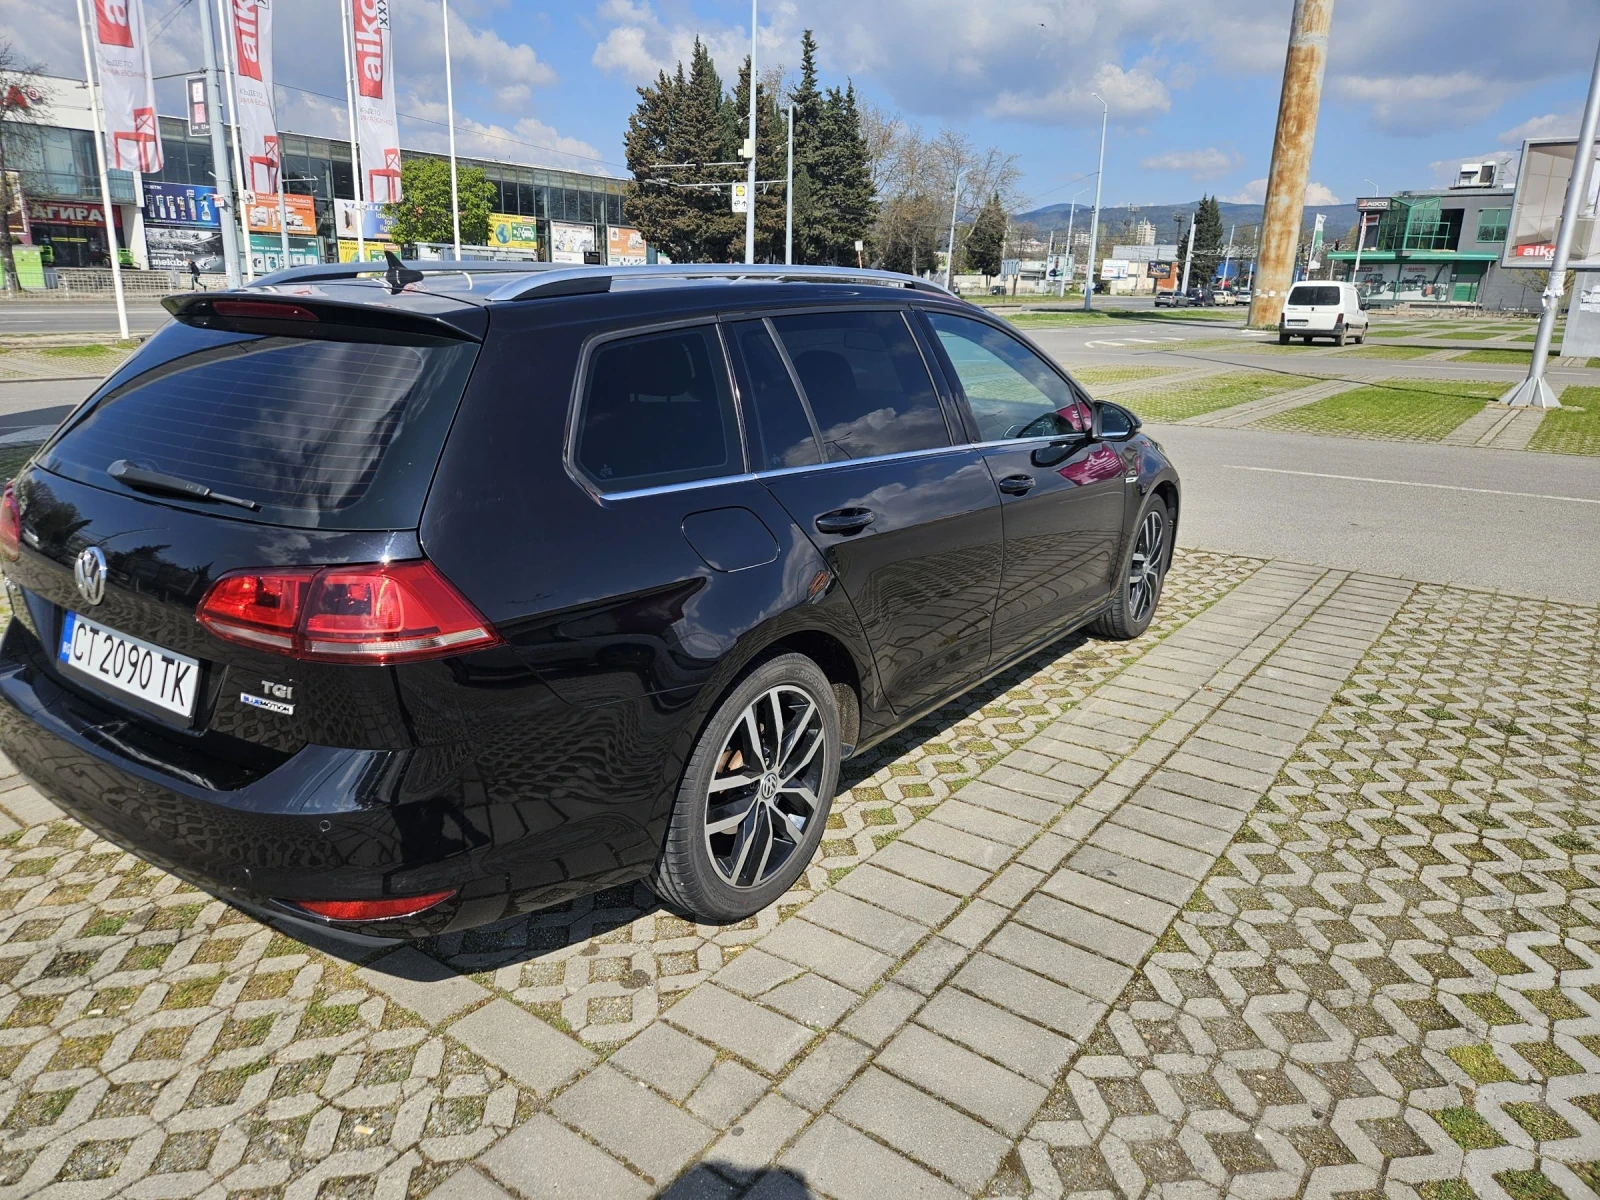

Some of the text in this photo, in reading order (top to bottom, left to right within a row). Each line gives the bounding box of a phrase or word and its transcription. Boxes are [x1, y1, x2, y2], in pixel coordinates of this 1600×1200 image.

[73, 622, 191, 707] CT 2090 TK
